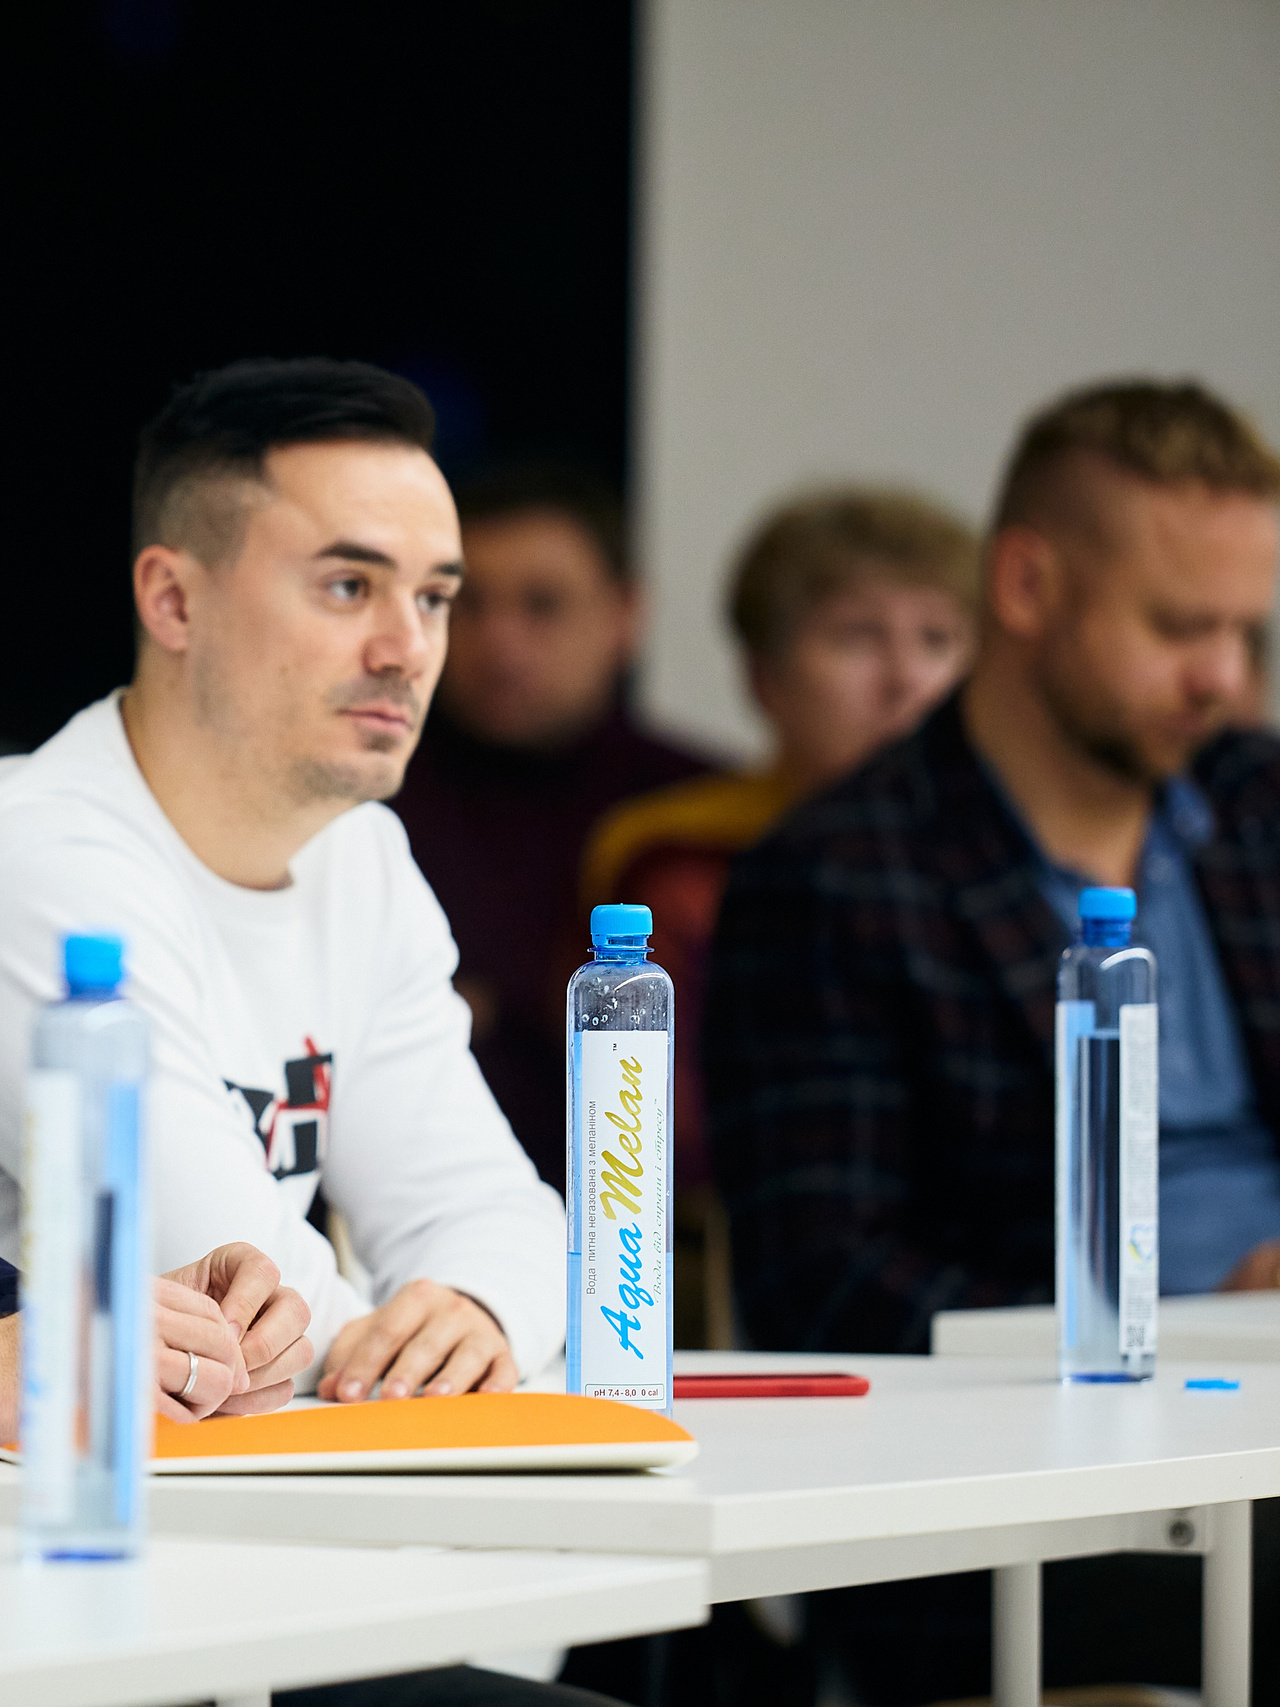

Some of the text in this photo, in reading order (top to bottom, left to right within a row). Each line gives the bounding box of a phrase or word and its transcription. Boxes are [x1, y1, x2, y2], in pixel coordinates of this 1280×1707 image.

[586, 1100, 596, 1157] меланіном
[588, 1168, 596, 1228] негазована
[588, 1231, 596, 1262] питна
[653, 1231, 662, 1254] від
[586, 1268, 597, 1295] Вода
[653, 1259, 662, 1303] Вода
[594, 1388, 606, 1397] pH
[647, 1388, 659, 1397] cal
